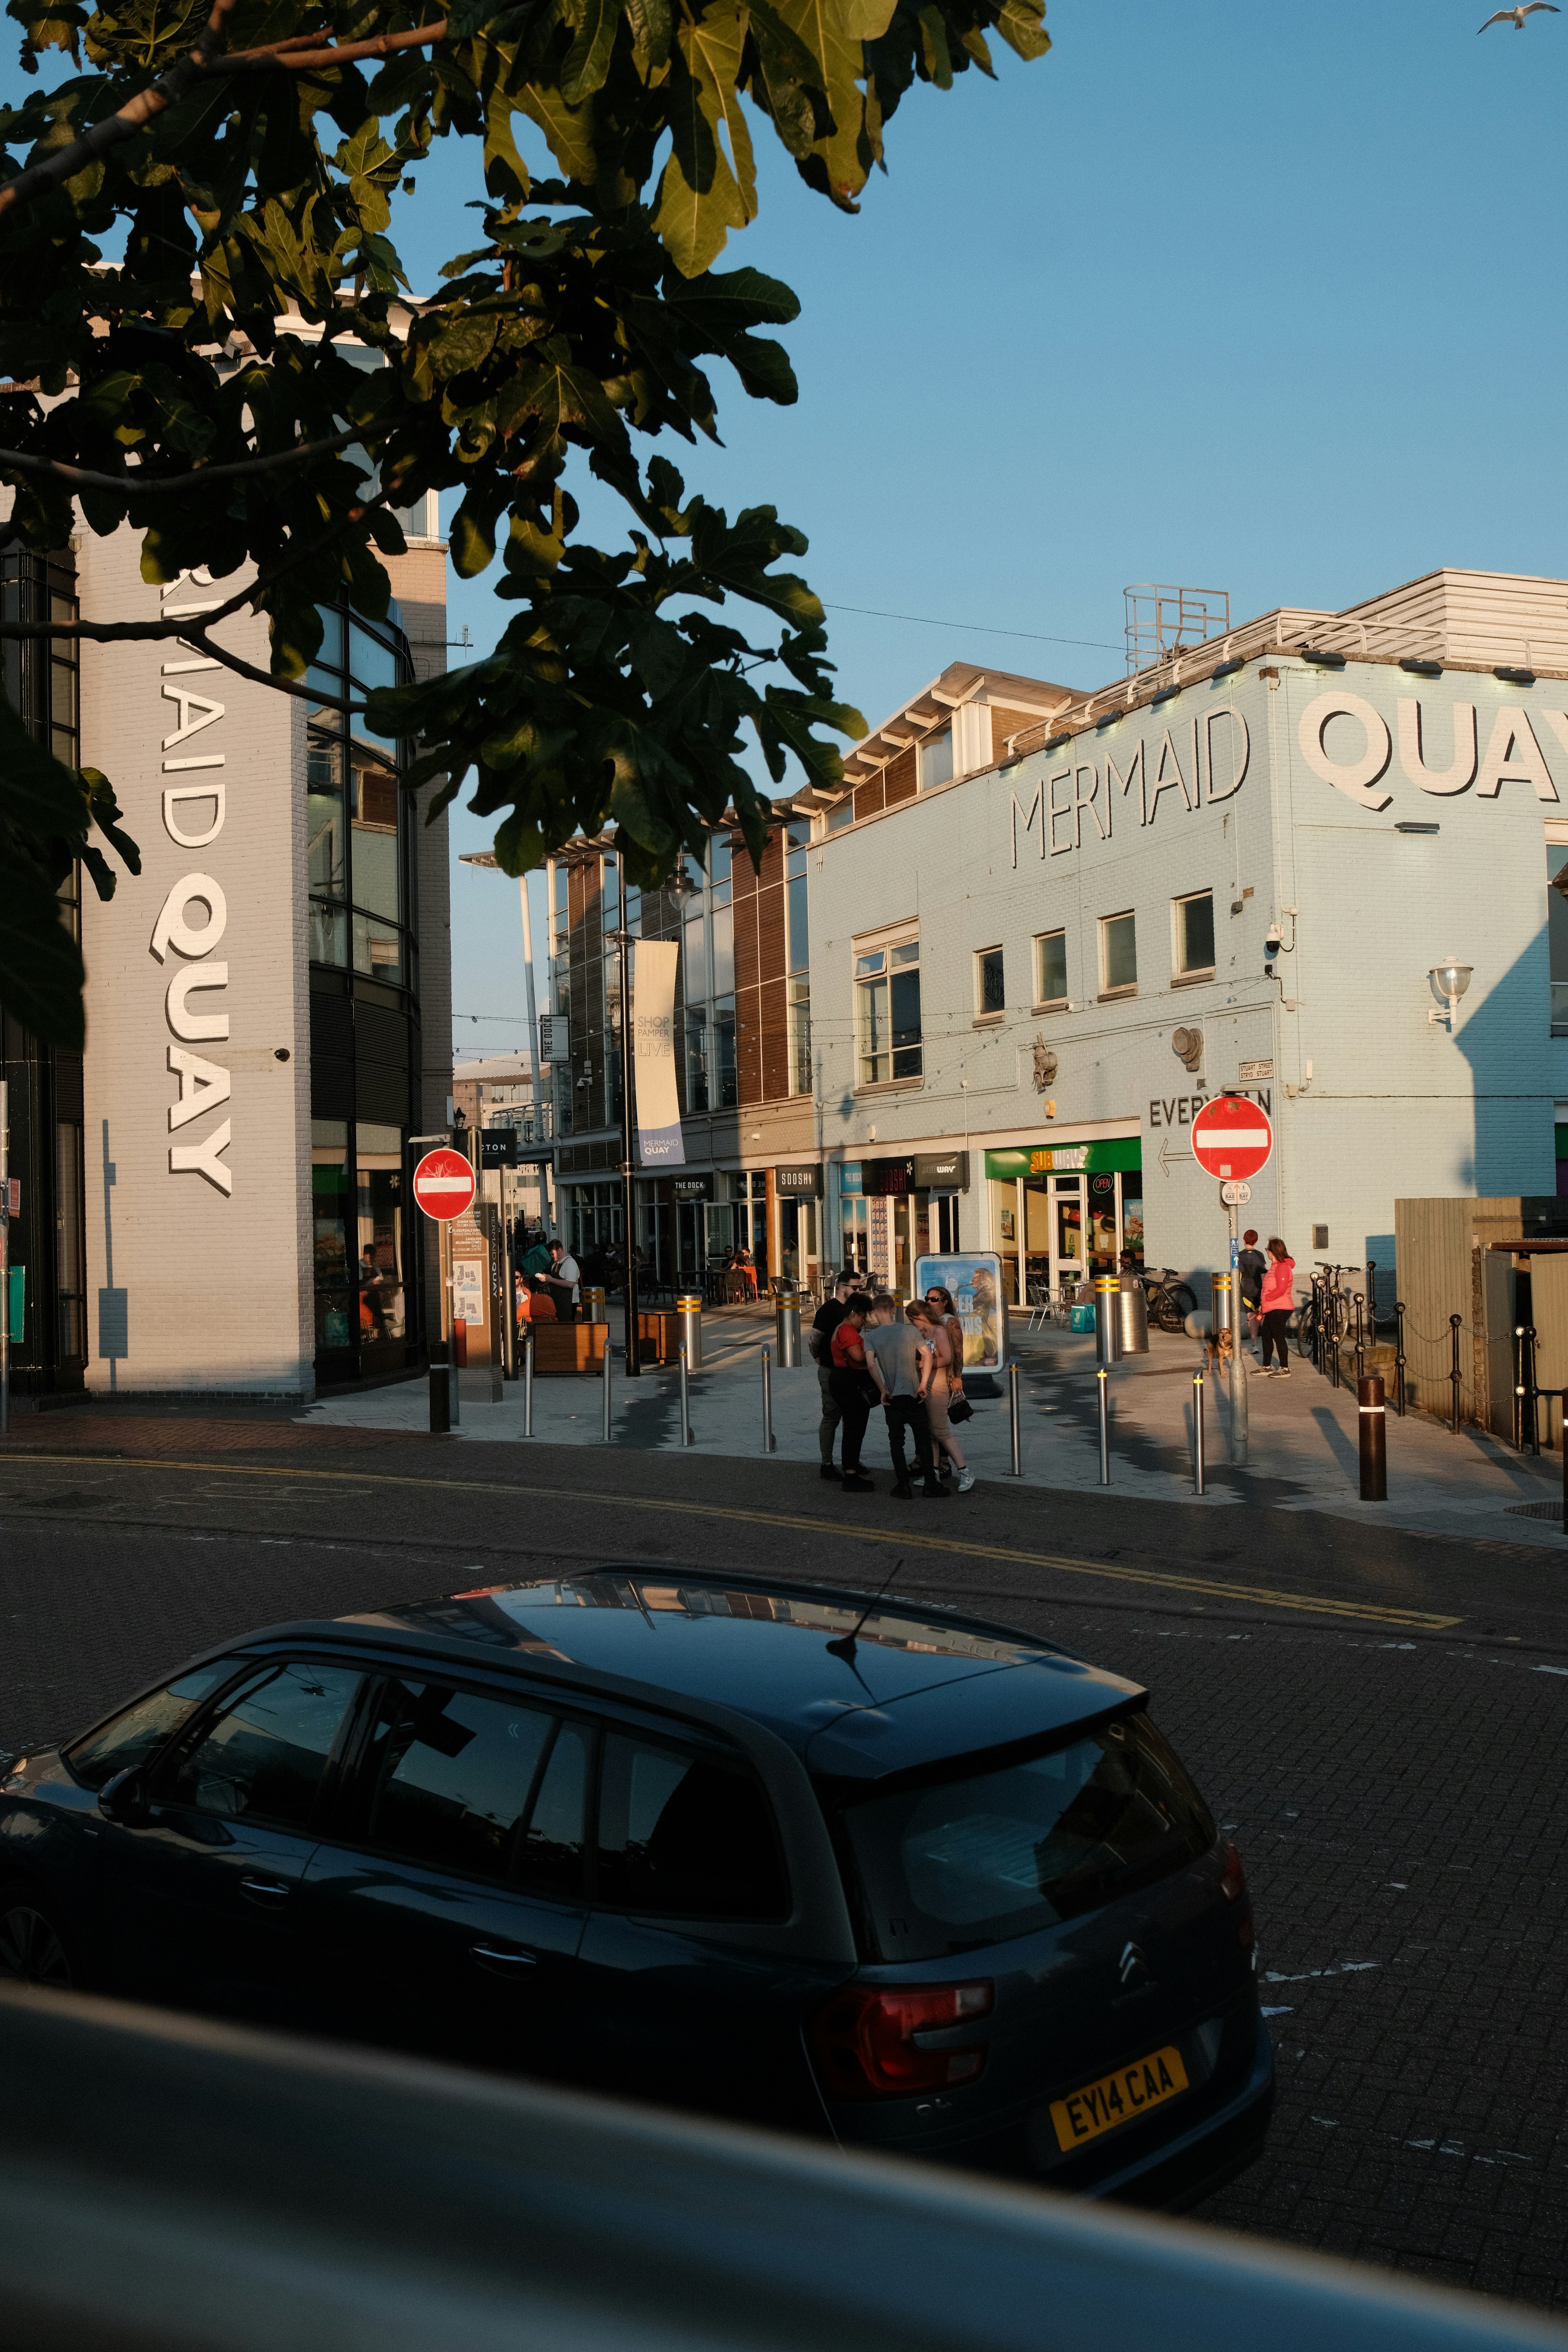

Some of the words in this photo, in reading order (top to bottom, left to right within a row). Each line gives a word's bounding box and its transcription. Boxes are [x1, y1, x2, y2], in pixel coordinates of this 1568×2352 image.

[161, 564, 225, 848] MAID
[1011, 704, 1250, 868] MERMAID
[544, 1018, 552, 1038] DOCK
[638, 1016, 669, 1027] SHOP
[150, 873, 232, 1198] QUAY
[544, 1041, 553, 1055] THE
[638, 1043, 670, 1057] LIVE
[1150, 1088, 1271, 1127] EVERN
[645, 1147, 669, 1155] QUAY
[1029, 1146, 1089, 1173] SUBWAY
[922, 1165, 956, 1174] SUBWAY
[782, 1173, 811, 1185] SOOSHI
[1096, 1178, 1110, 1188] OPEN
[1066, 2081, 1123, 2137] EY14
[1127, 2056, 1173, 2106] CAA
